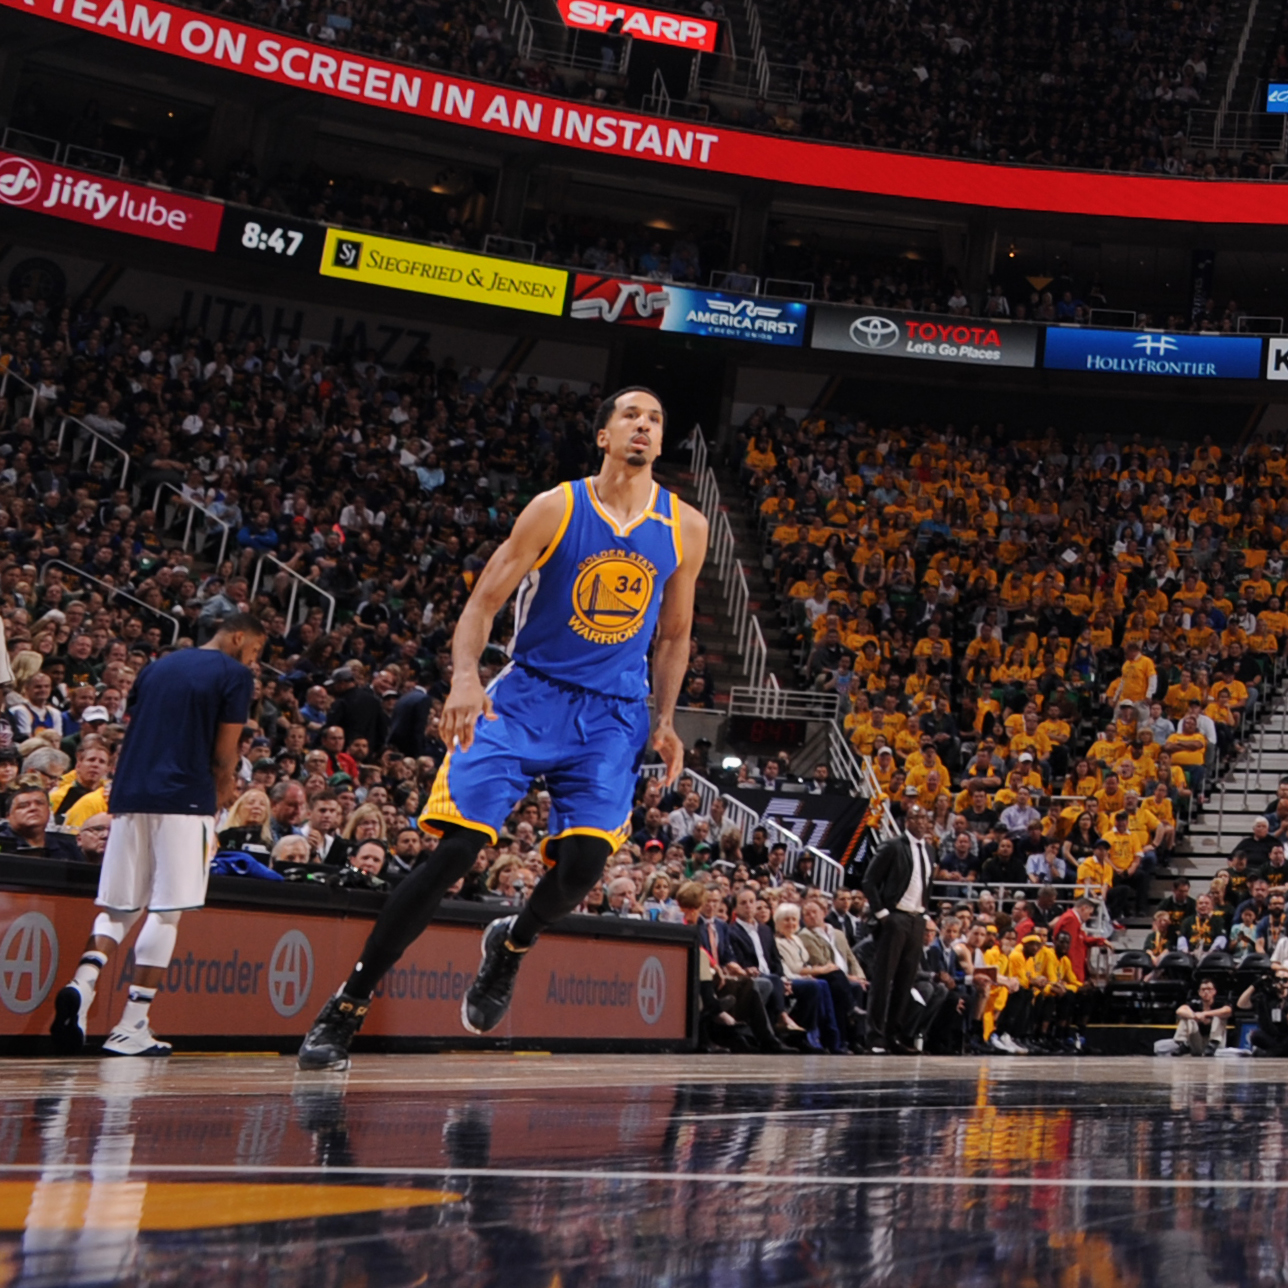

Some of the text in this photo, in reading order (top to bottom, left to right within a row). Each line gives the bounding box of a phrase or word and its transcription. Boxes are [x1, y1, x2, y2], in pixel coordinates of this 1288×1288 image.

[567, 0, 707, 43] SHARP
[180, 19, 248, 65] ON
[254, 39, 422, 109] SCREEN
[430, 81, 475, 119] IN
[481, 94, 543, 134] AN
[551, 107, 719, 163] INSTANT
[241, 221, 303, 257] 8:47
[366, 248, 557, 301] SIEGFRIED & JENSEN
[685, 309, 798, 335] AMERICA FIRST
[706, 325, 739, 337] CREDIT
[904, 319, 1001, 347] TOYOTA
[905, 340, 1001, 361] Let's Go Places
[578, 548, 659, 577] GOLDEN STATE
[614, 575, 643, 596] 34
[567, 614, 645, 645] WARRIORS
[546, 968, 635, 1009] Autotrader
